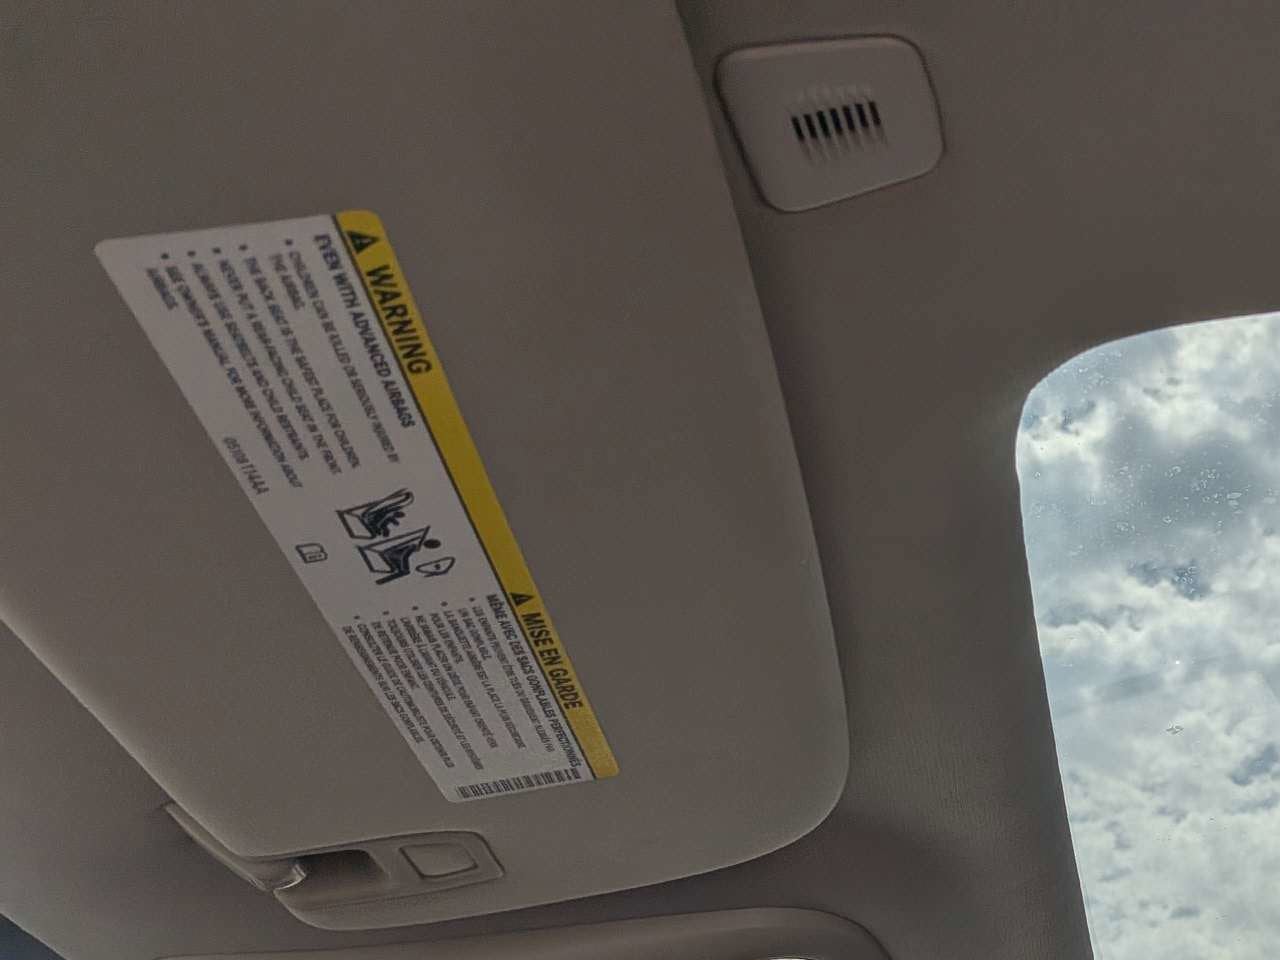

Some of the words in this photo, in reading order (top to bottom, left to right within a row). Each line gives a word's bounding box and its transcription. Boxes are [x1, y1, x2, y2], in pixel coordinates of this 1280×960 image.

[312, 234, 345, 270] EVEN
[331, 273, 362, 308] WITH
[348, 311, 394, 377] ADVANCED
[380, 378, 417, 427] AIRBAGS
[362, 265, 435, 374] WARNING
[485, 593, 509, 619] MÊME
[498, 620, 518, 640] AVEC
[521, 612, 556, 647] MISE
[508, 640, 526, 655] DES
[538, 647, 565, 666] EN
[516, 656, 535, 674] SACS
[526, 674, 556, 717] GONFLABLES
[546, 666, 584, 709] GARDE
